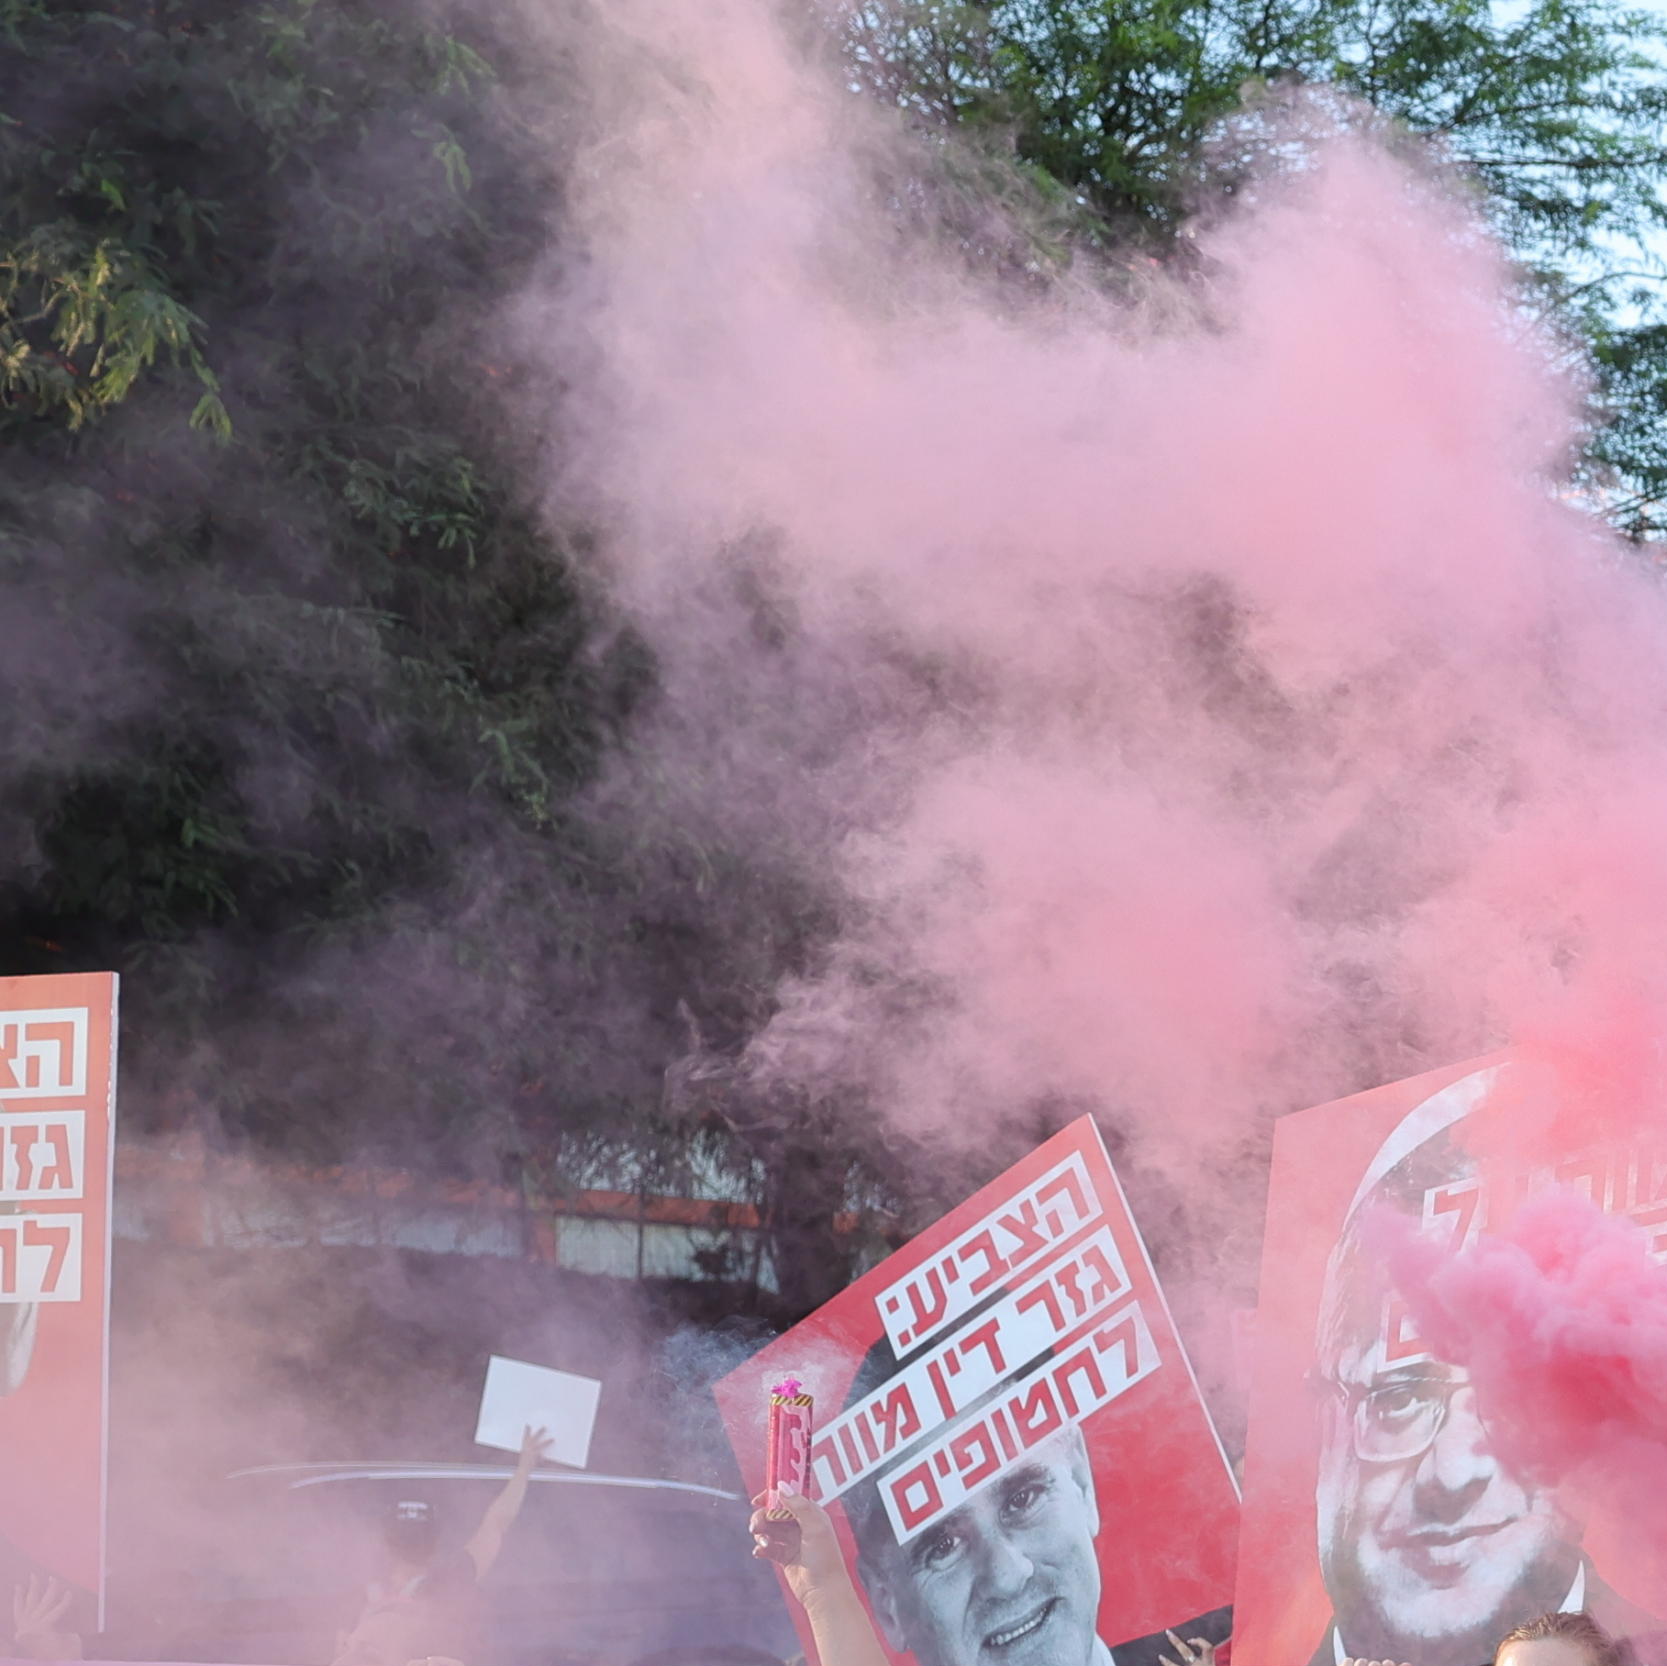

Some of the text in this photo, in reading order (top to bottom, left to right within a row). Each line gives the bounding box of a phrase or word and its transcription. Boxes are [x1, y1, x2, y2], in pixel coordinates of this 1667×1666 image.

[0, 1124, 73, 1191] גז
[888, 1167, 1091, 1346] הצביע:
[1015, 1244, 1122, 1333] גזר
[889, 1317, 1140, 1531] לחטופים
[926, 1317, 1007, 1421] דין
[811, 1381, 922, 1501] מוות
